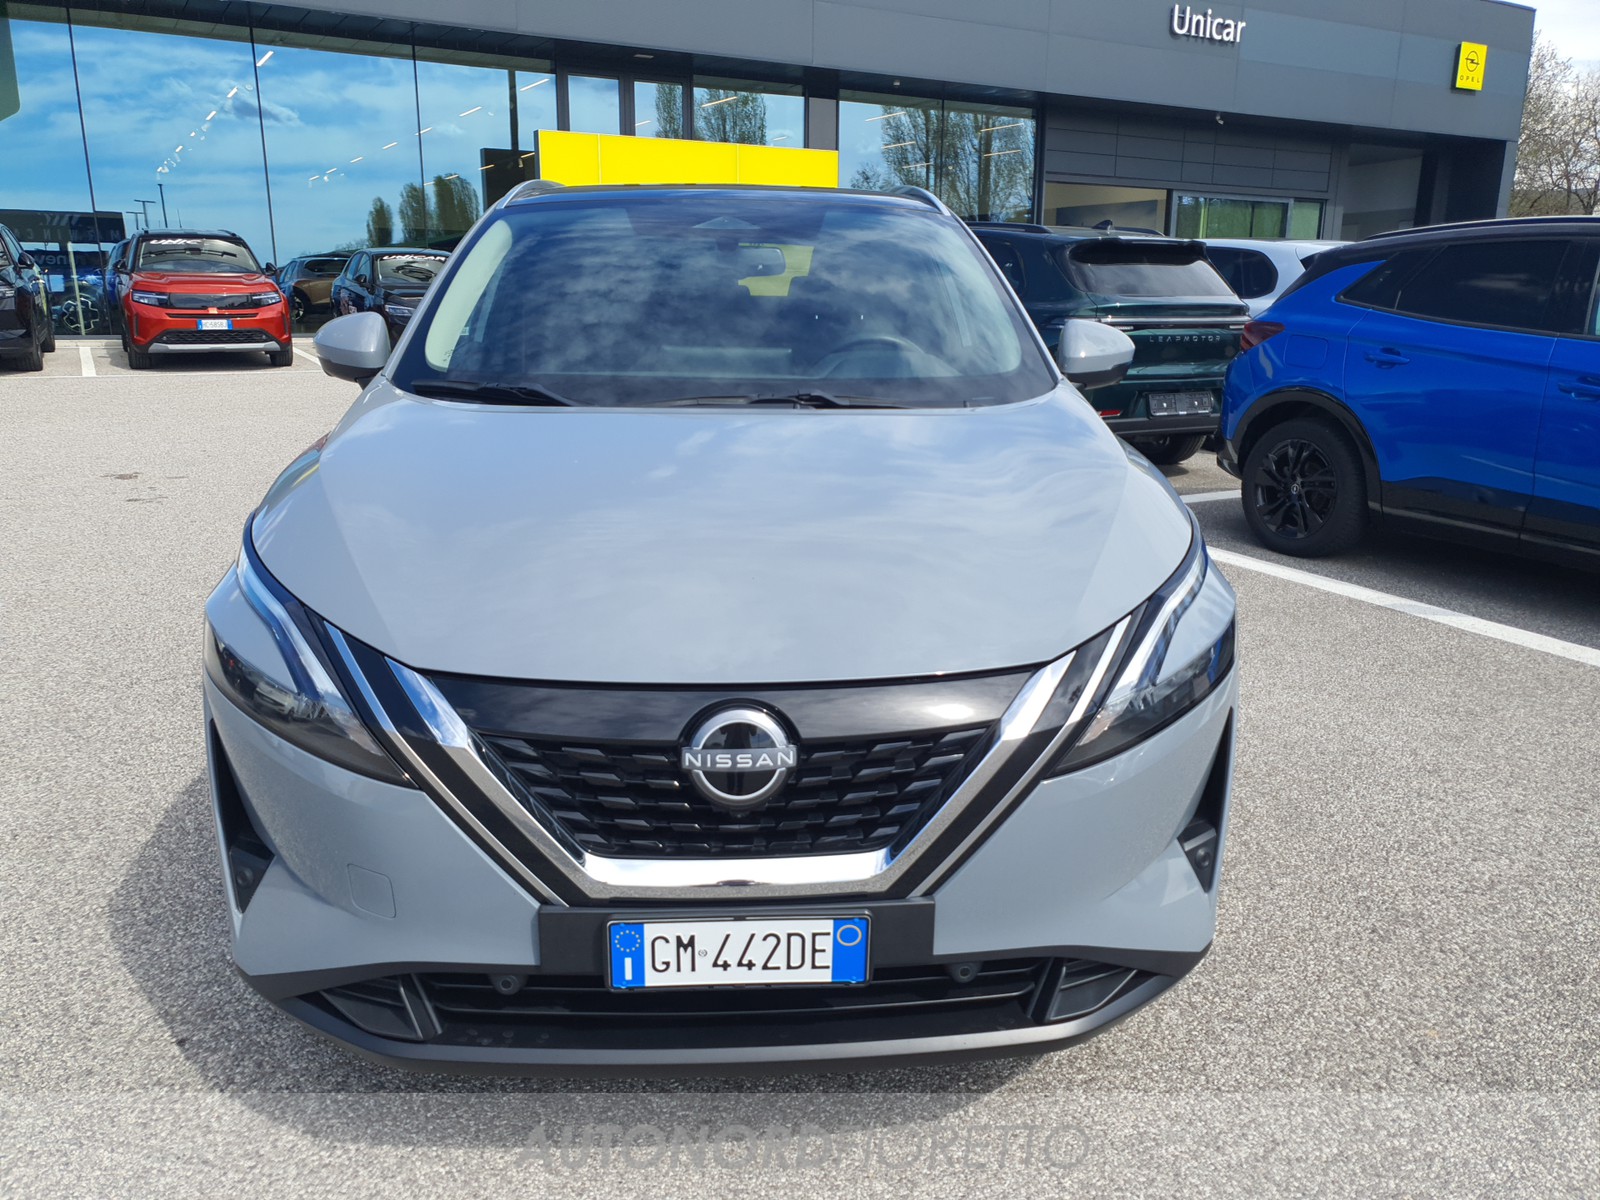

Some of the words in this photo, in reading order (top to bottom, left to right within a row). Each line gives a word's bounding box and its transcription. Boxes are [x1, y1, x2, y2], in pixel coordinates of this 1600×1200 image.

[1172, 4, 1246, 42] Unicar
[1459, 74, 1480, 84] OPEL
[1149, 335, 1221, 343] LEAPMOTOR
[685, 750, 794, 768] NISSAN
